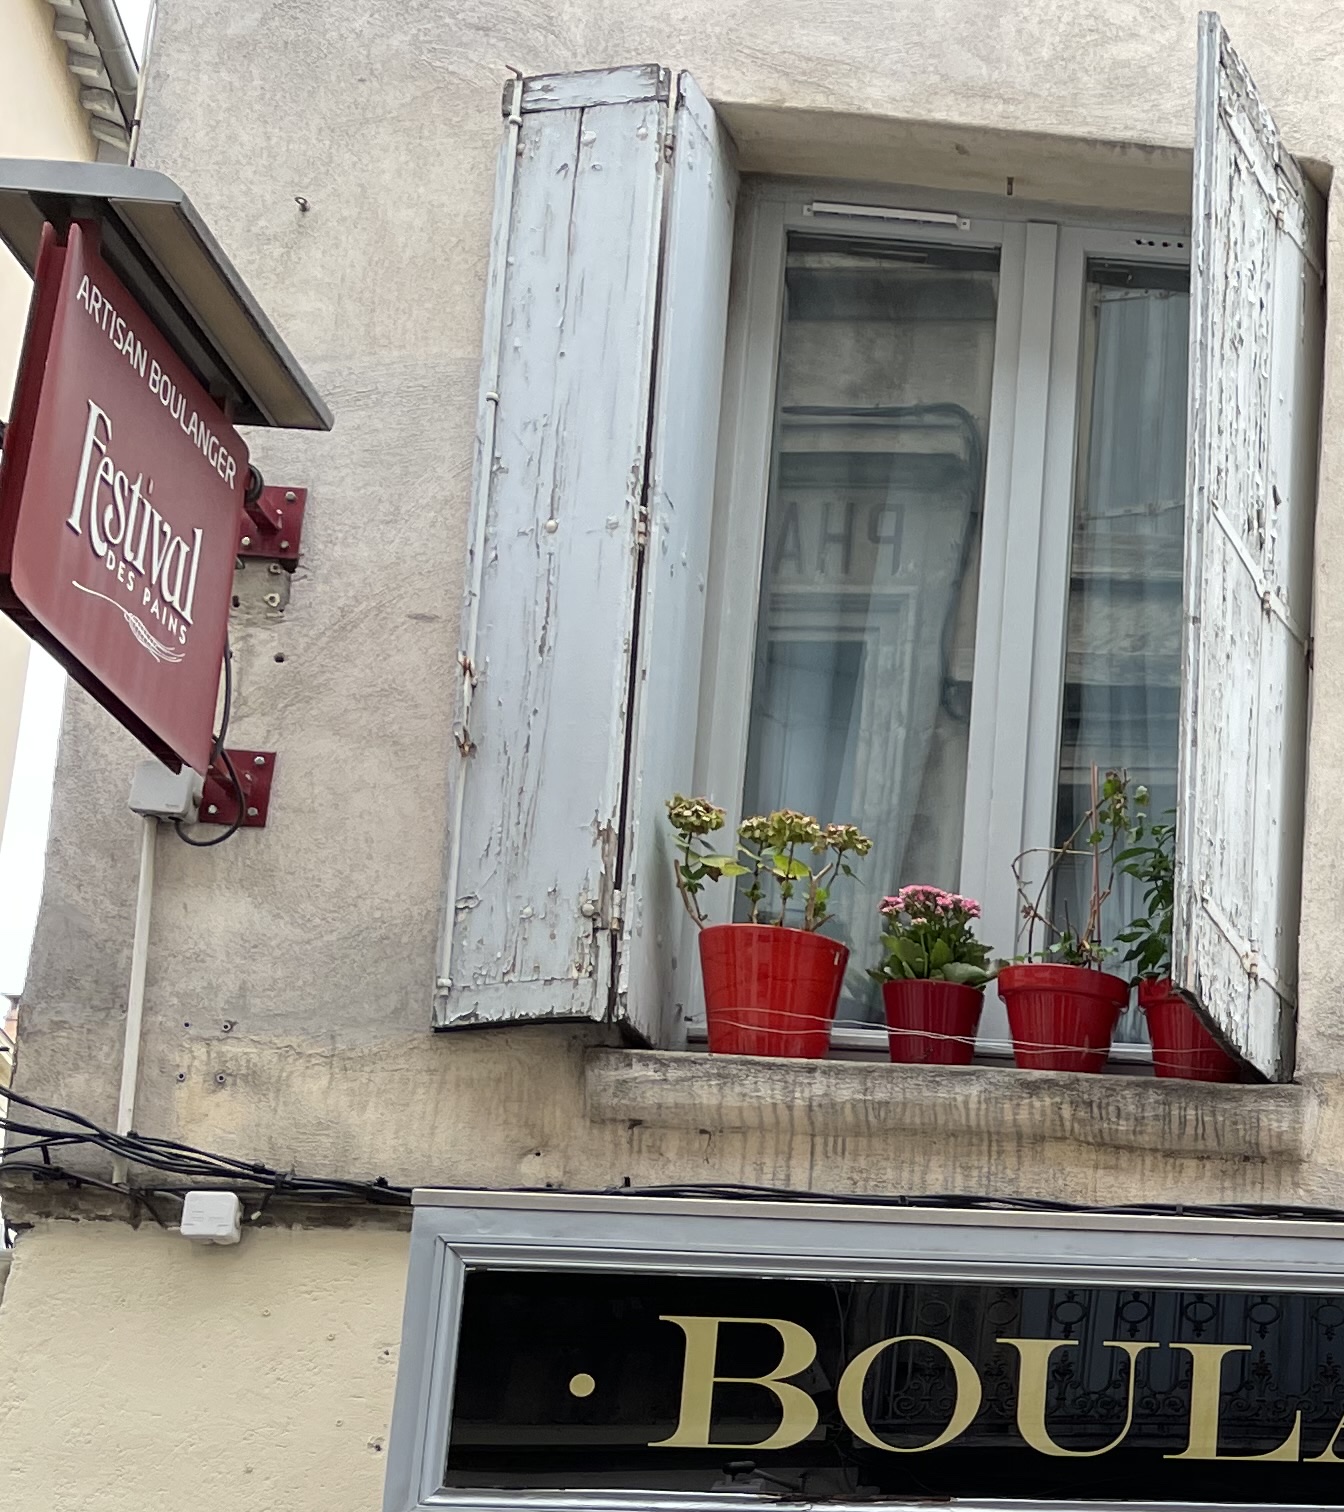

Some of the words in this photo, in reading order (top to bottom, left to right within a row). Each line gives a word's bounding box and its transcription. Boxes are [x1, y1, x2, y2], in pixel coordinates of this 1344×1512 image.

[77, 275, 147, 377] ARTISAN
[149, 359, 237, 490] BOULANGER
[66, 399, 203, 625] Festival
[106, 549, 135, 591] DES
[143, 586, 187, 644] PAINS
